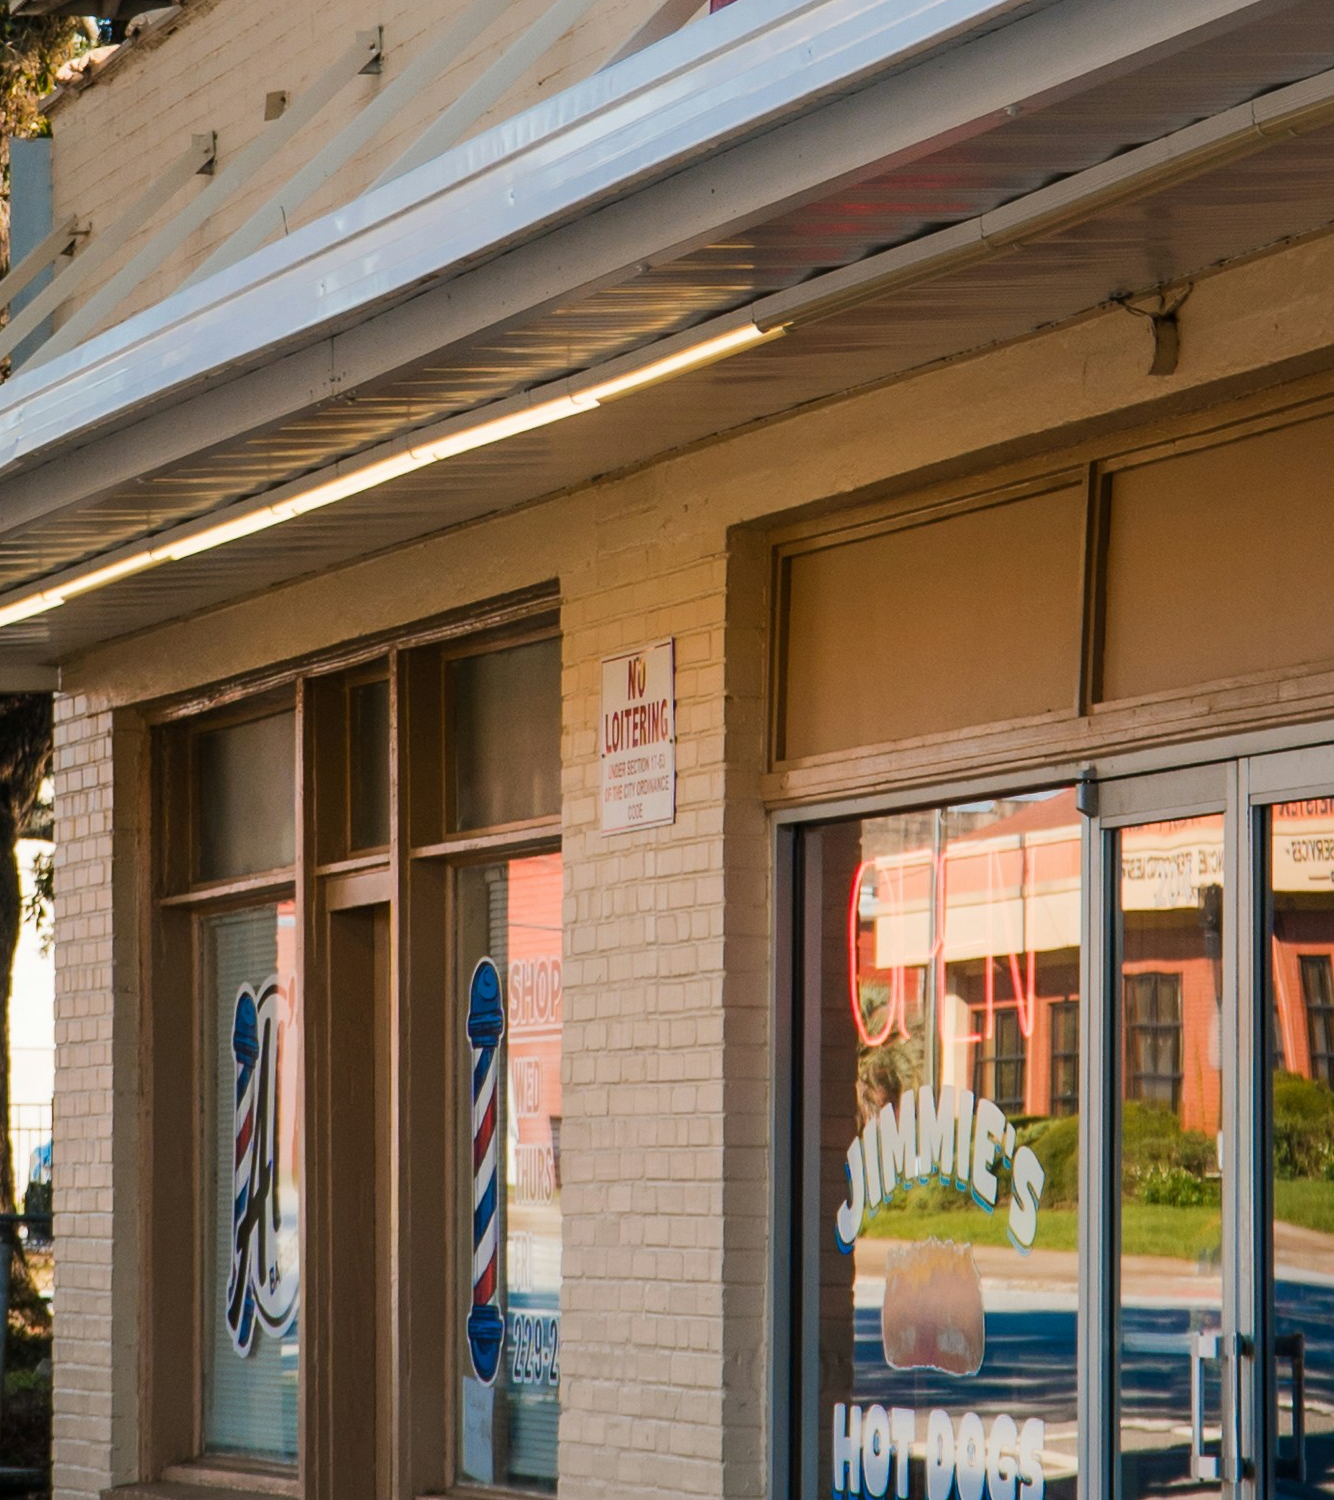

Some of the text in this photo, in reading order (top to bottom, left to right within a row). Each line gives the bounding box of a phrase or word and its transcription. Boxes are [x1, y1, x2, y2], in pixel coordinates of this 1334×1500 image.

[627, 655, 646, 701] NO
[604, 698, 669, 755] LOITERING
[608, 761, 626, 780] UNDER
[627, 757, 650, 776] SECTION
[508, 953, 563, 1027] SHOP
[514, 1056, 543, 1119] WED
[515, 1143, 556, 1207] THURS
[835, 1084, 1046, 1256] JIMMIE'S
